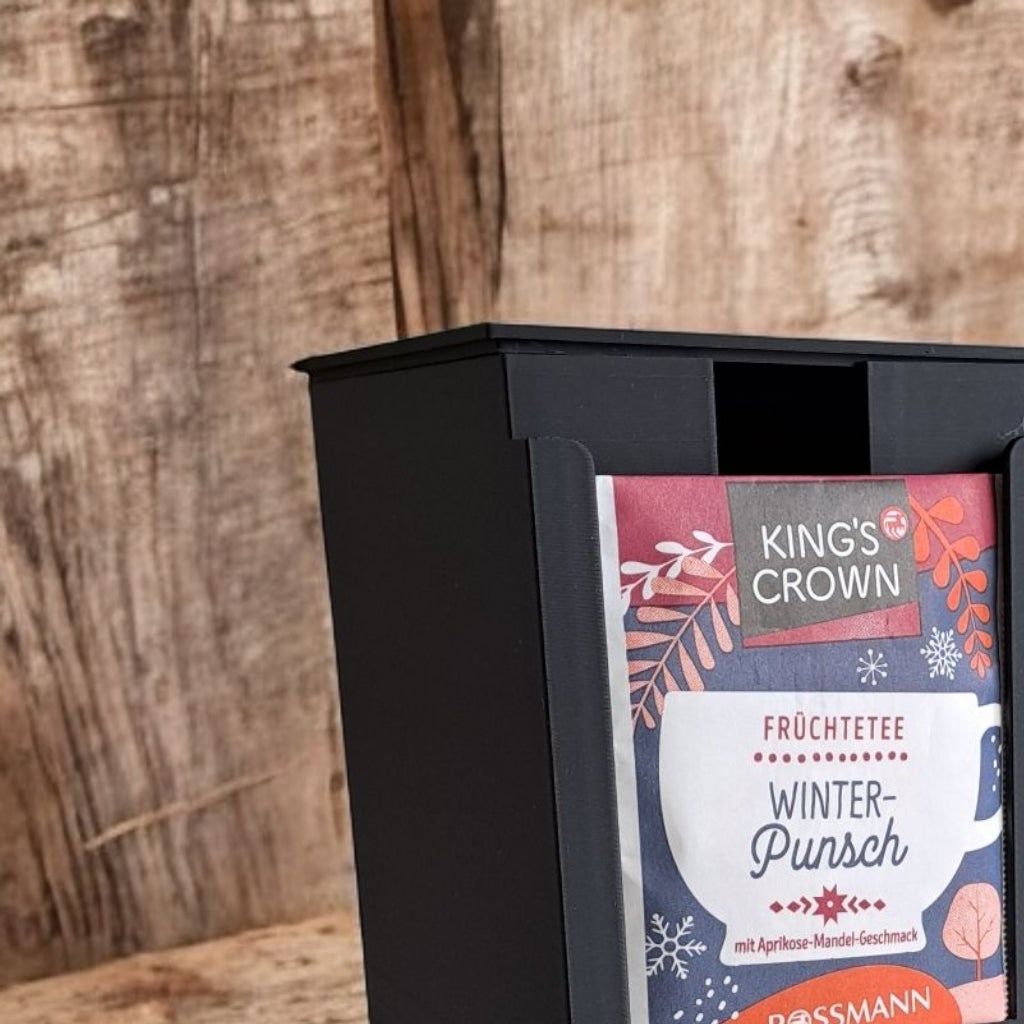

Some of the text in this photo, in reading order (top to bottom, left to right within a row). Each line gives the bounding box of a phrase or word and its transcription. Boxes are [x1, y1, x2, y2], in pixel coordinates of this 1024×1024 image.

[761, 517, 880, 560] KING'S
[752, 563, 900, 604] CROWN
[763, 711, 905, 741] FRÜCHTETEE
[769, 780, 897, 820] WINTER-
[750, 817, 909, 879] Punsch
[735, 928, 919, 957] mit Aprikose-Mandel-Geschmack
